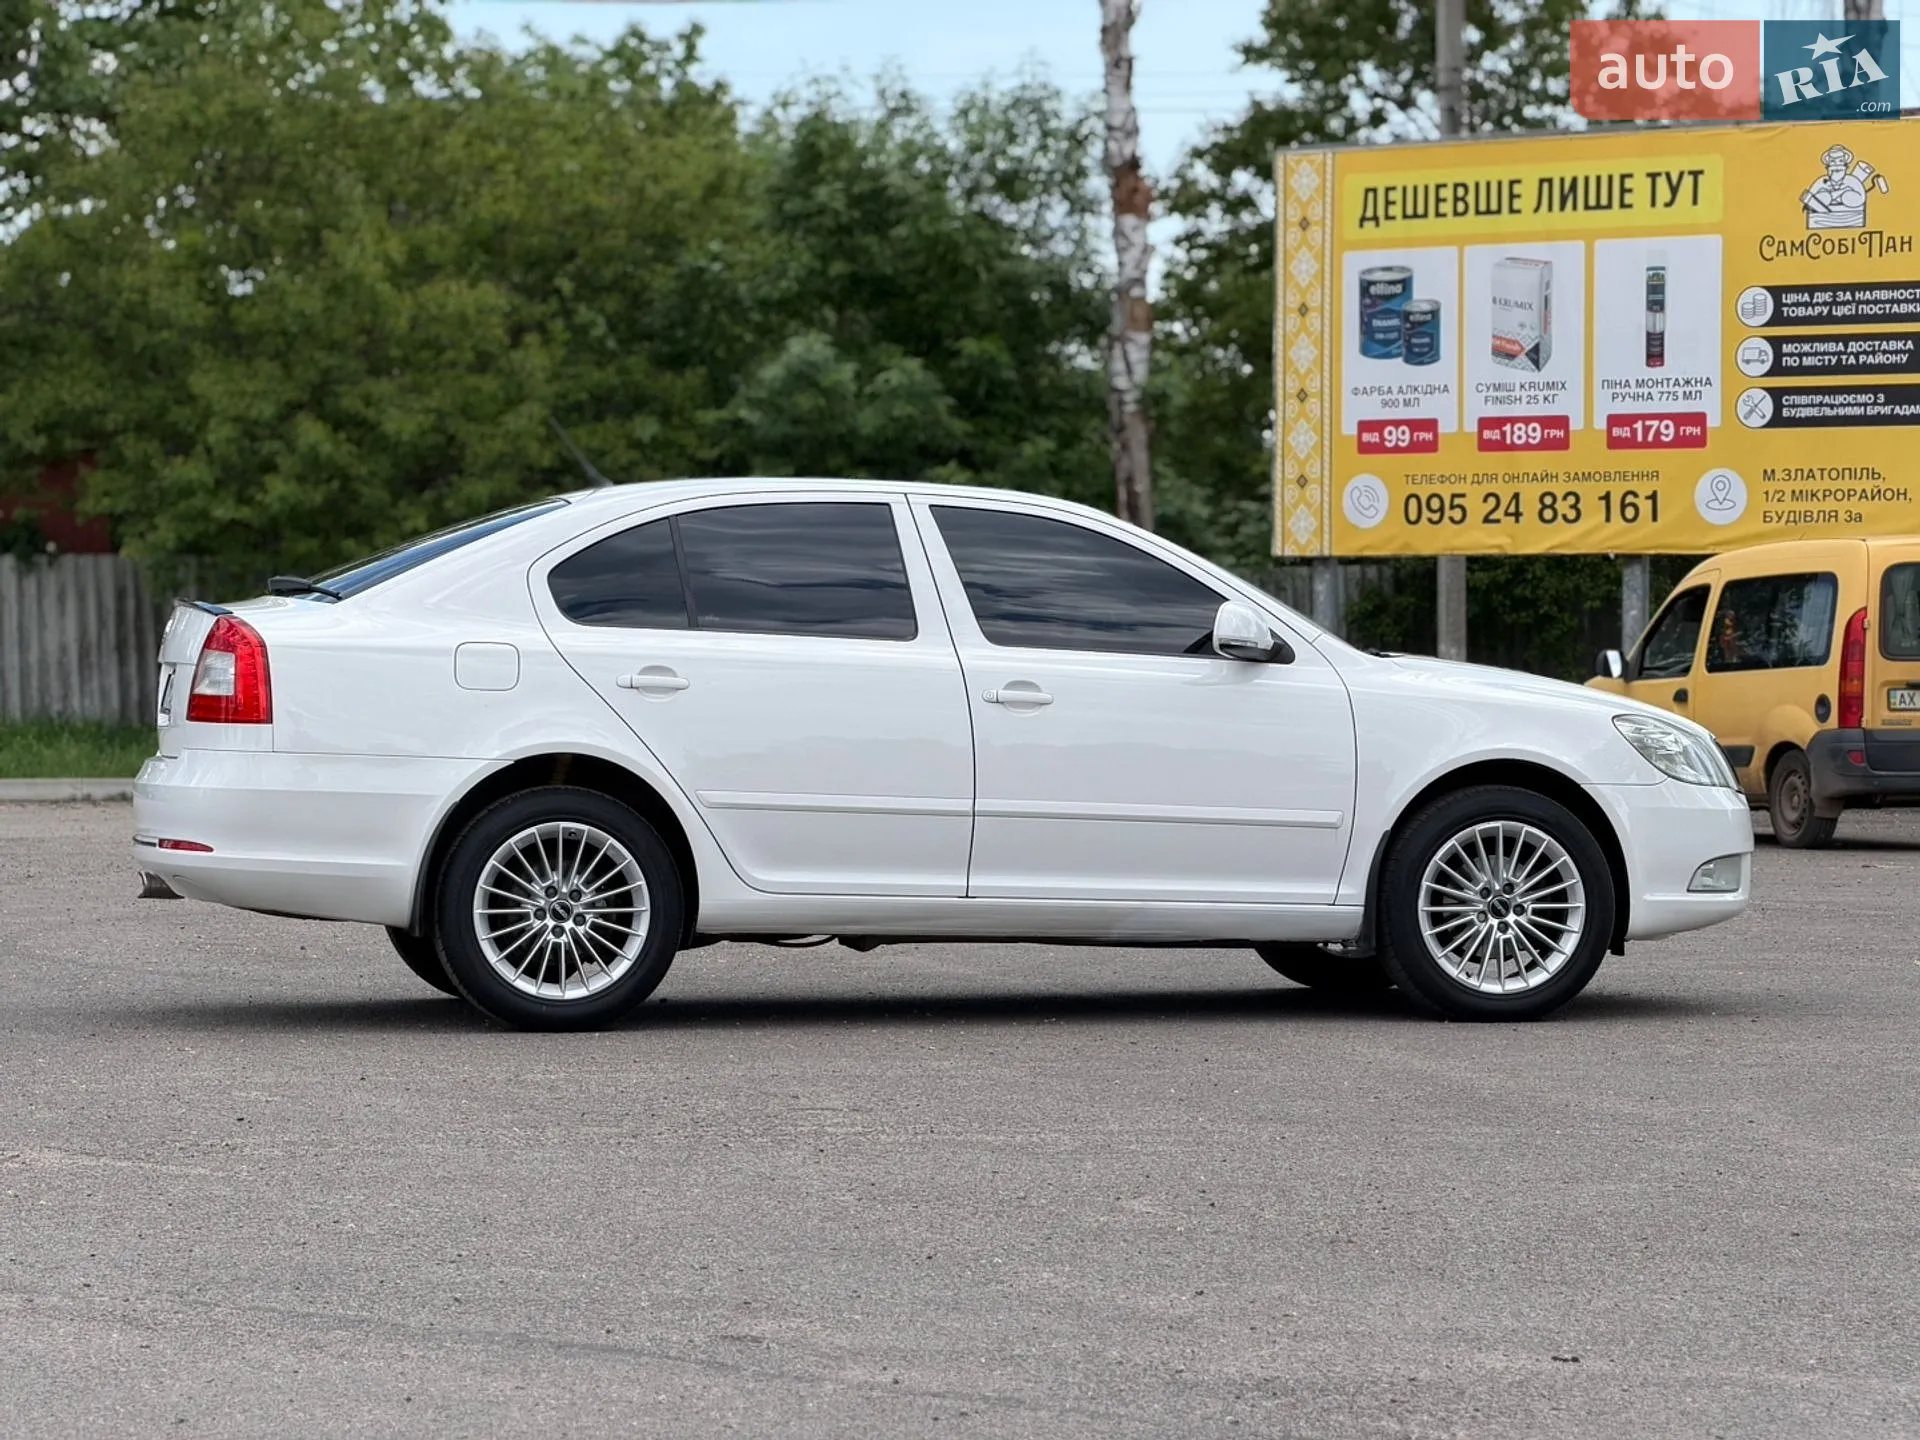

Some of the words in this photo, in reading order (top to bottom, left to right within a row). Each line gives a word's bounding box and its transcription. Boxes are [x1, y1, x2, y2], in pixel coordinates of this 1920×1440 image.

[1359, 179, 1522, 228] ДЕШЕВШЕ
[1533, 173, 1634, 214] ЛИШЕ
[1646, 170, 1705, 208] ТУТ
[1782, 292, 1811, 304] ЦІНА
[1812, 291, 1833, 304] ДІЄ
[1836, 291, 1852, 301] ЗА
[1782, 305, 1830, 317] ТОВАРУ
[1832, 304, 1856, 317] ЦІЄЇ
[1782, 342, 1845, 354] МОЖЛИВА
[1847, 340, 1915, 353] ДОСТАВКА
[1782, 356, 1799, 367] ПО
[1802, 355, 1838, 366] МІСТУ
[1840, 354, 1856, 365] ТА
[1859, 352, 1909, 365] РАЙОНУ
[1351, 384, 1394, 397] ФАРБА
[1397, 383, 1450, 396] АЛКІДНА
[1475, 382, 1516, 393] СУМІШ
[1520, 380, 1567, 392] KRUMIX
[1601, 379, 1632, 390] ПІНА
[1635, 376, 1713, 390] МОНТАЖНА
[1380, 398, 1400, 409] 900
[1403, 397, 1421, 409] МЛ
[1484, 395, 1522, 406] FINISH
[1526, 394, 1540, 405] 25
[1543, 393, 1560, 405] КГ
[1611, 391, 1655, 403] РУЧНА
[1657, 390, 1679, 402] 775
[1682, 390, 1703, 401] МЛ
[1782, 394, 1875, 406] СПІВПРАЦЮЄМО
[1782, 407, 1865, 418] БУДІВЕЛЬНИМИ
[1362, 432, 1380, 443] ВІД
[1383, 425, 1411, 448] 99
[1413, 431, 1433, 442] ГРН
[1482, 429, 1501, 441] ВІД
[1502, 422, 1542, 445] 189
[1544, 429, 1564, 439] ГРН
[1612, 426, 1631, 438] ВІД
[1632, 419, 1675, 443] 179
[1679, 426, 1701, 436] ГРН
[1404, 473, 1467, 485] ТЕЛЕФОН
[1471, 473, 1498, 487] ДЛЯ
[1502, 469, 1559, 485] ОНЛАЙН
[1562, 470, 1660, 483] ЗАМОВЛЕННЯ
[1762, 467, 1886, 482] М.ЗЛАТОПІЛЬ,
[1763, 489, 1786, 503] 1/2
[1790, 485, 1912, 504] МІКРОРАЙОН,
[1403, 492, 1468, 525] 095
[1481, 491, 1523, 525] 24
[1537, 490, 1582, 525] 83
[1597, 490, 1660, 524] 161
[1762, 510, 1839, 525] БУДІВЛЯ
